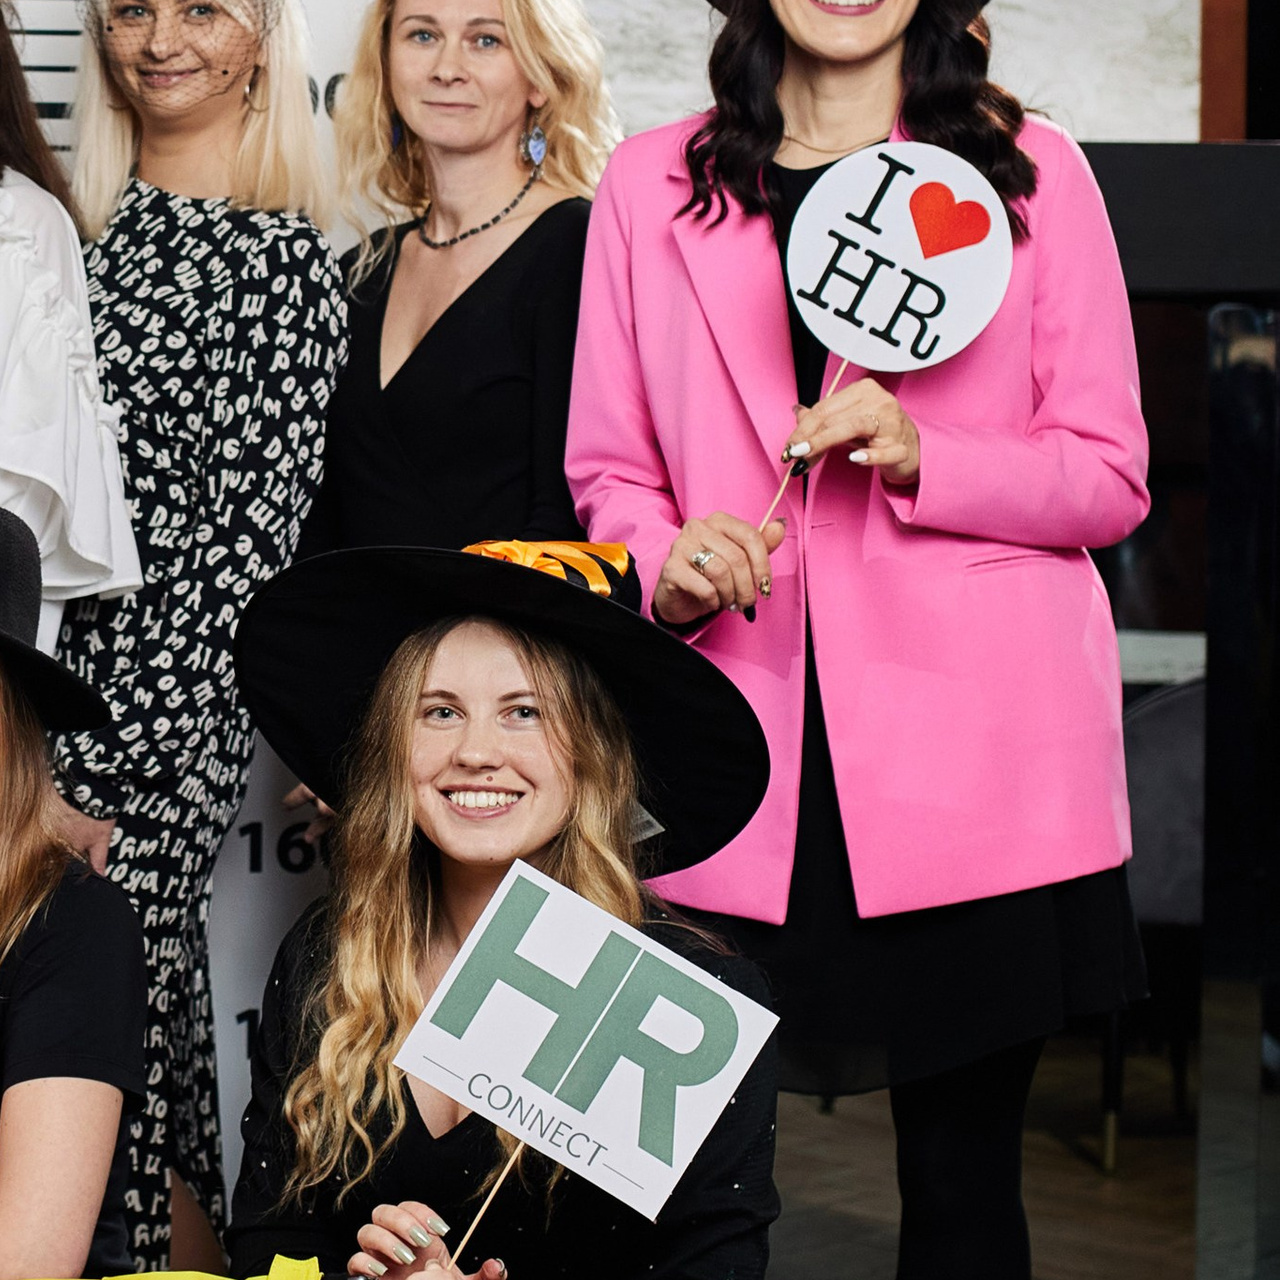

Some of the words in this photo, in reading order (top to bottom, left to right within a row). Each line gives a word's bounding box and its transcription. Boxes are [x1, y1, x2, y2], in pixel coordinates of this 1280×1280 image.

[845, 152, 915, 235] I
[796, 229, 946, 360] HR
[238, 821, 328, 874] 16
[429, 874, 739, 1169] HR
[466, 1072, 608, 1168] CONNECT
